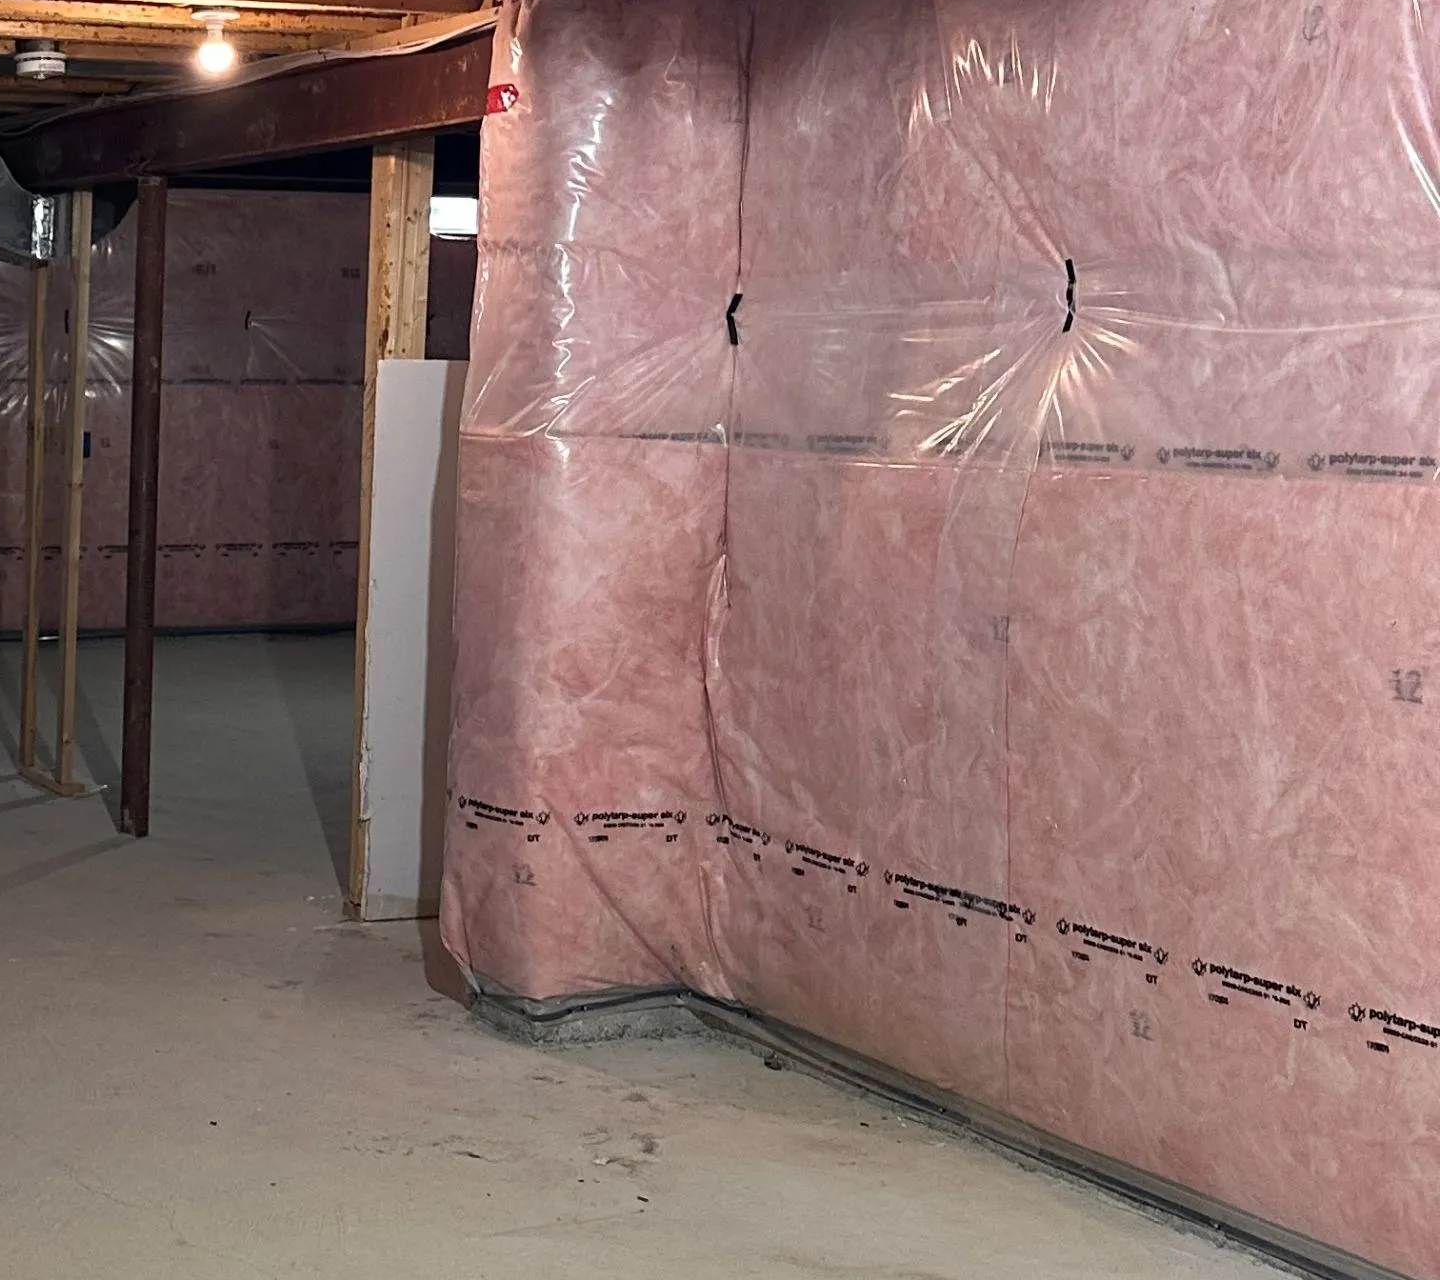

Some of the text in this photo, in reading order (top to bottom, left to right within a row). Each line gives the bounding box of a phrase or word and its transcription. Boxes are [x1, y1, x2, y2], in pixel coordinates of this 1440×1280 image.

[1329, 452, 1436, 467] polytarp-super six
[592, 811, 673, 821] polytarp-super six
[666, 834, 678, 842] DT
[1072, 922, 1137, 949] polytarp-super
[1210, 963, 1284, 992] polytarp-super
[1286, 985, 1302, 998] six
